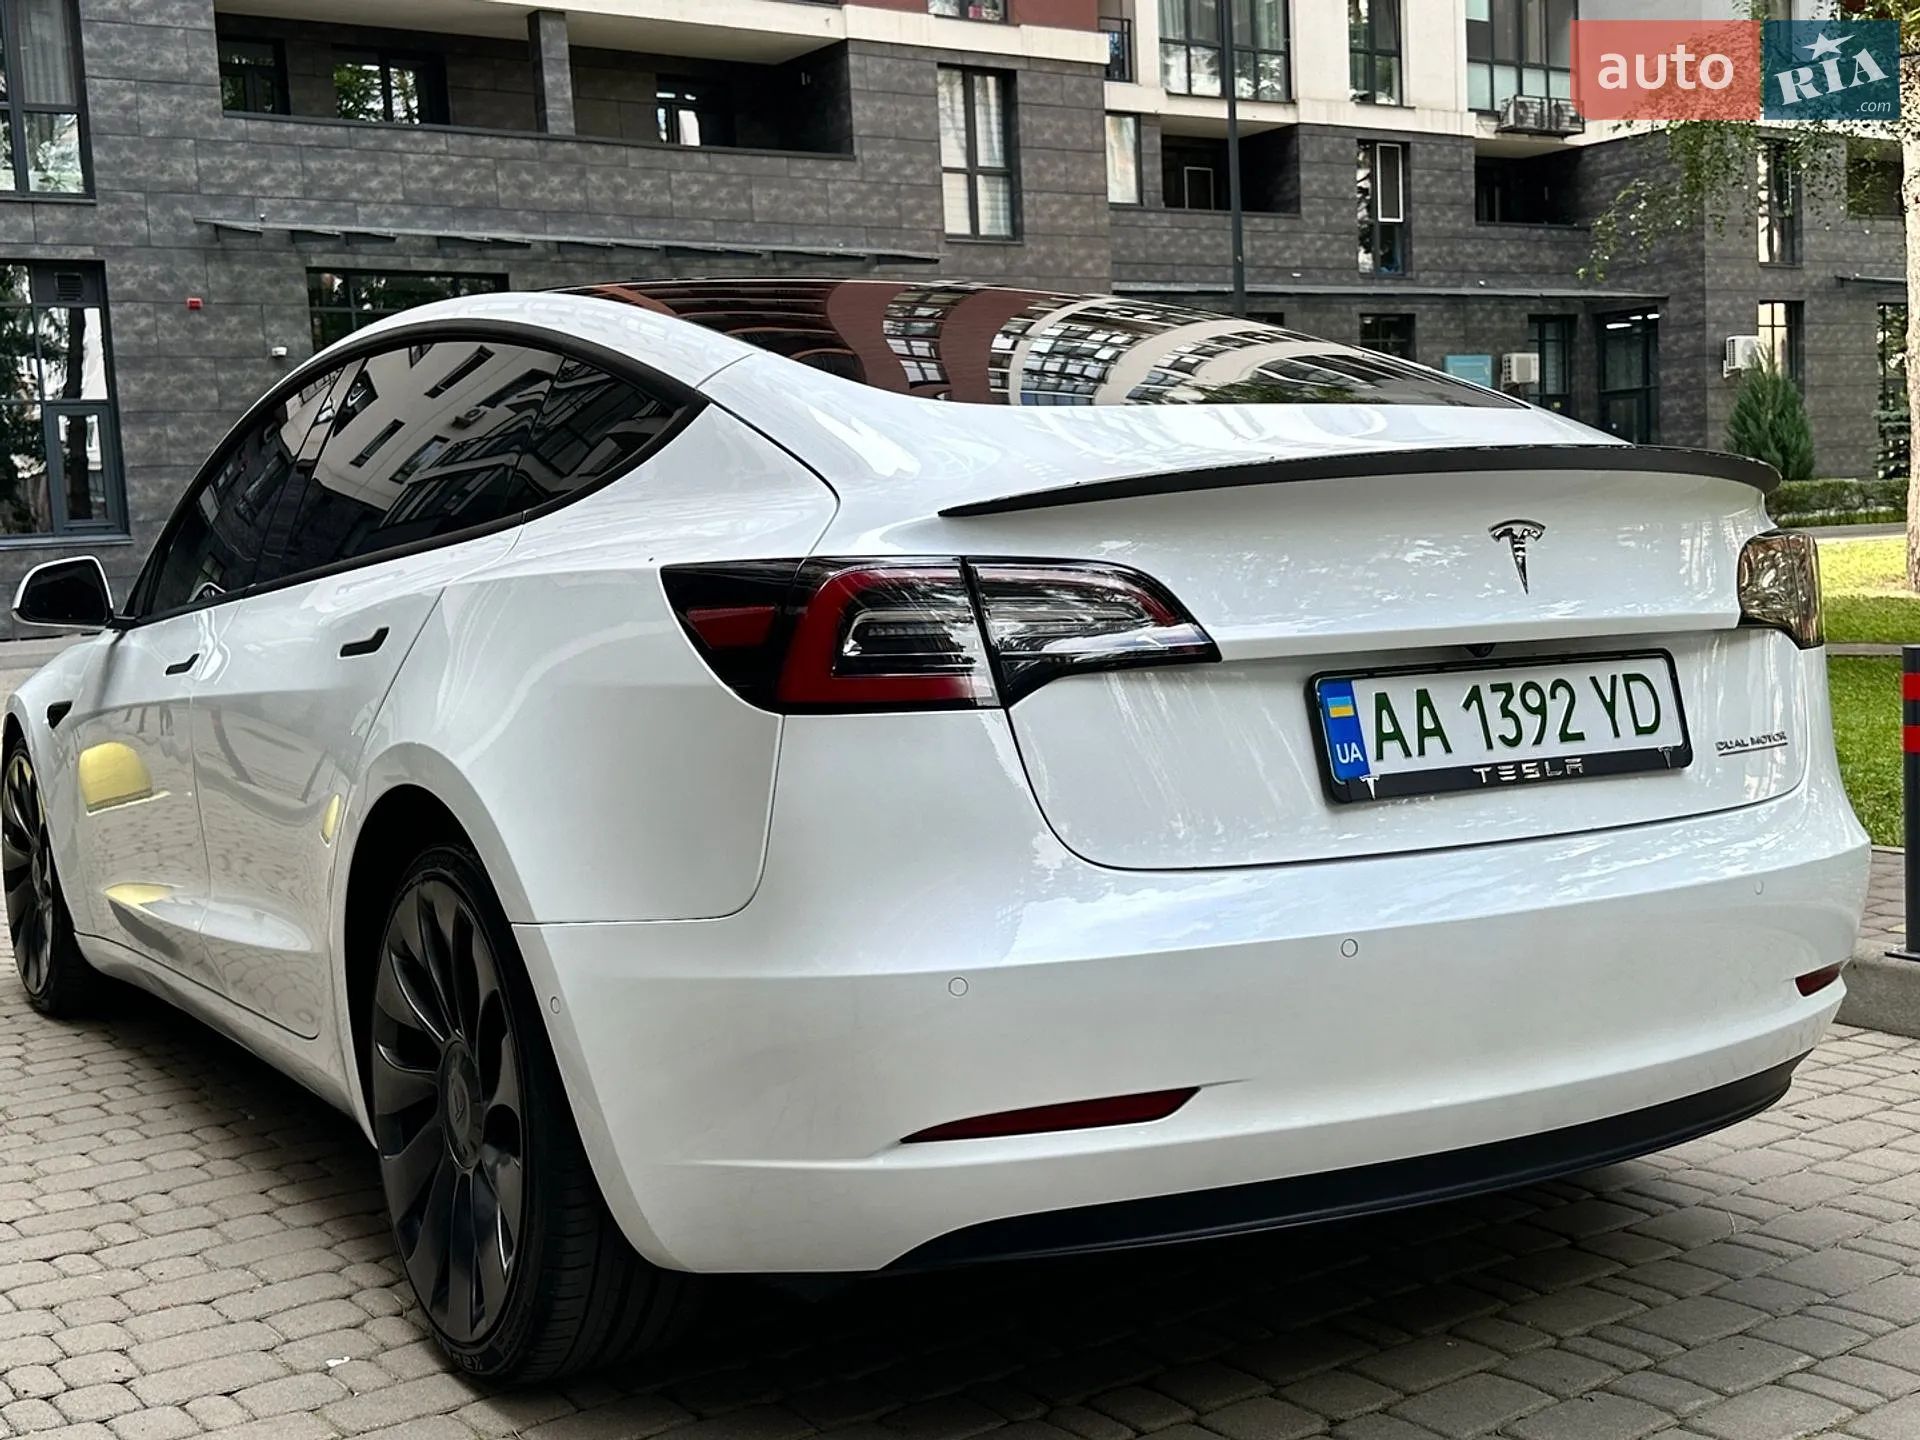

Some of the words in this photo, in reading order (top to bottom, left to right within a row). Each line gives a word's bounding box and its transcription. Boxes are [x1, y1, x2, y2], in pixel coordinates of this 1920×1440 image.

[1374, 688, 1453, 761] AA
[1461, 678, 1586, 751] 1392
[1589, 673, 1662, 738] YD
[1715, 739, 1749, 751] DUAL
[1750, 731, 1787, 746] MOTOR
[1336, 743, 1364, 765] UA
[1472, 757, 1584, 784] TESLA
